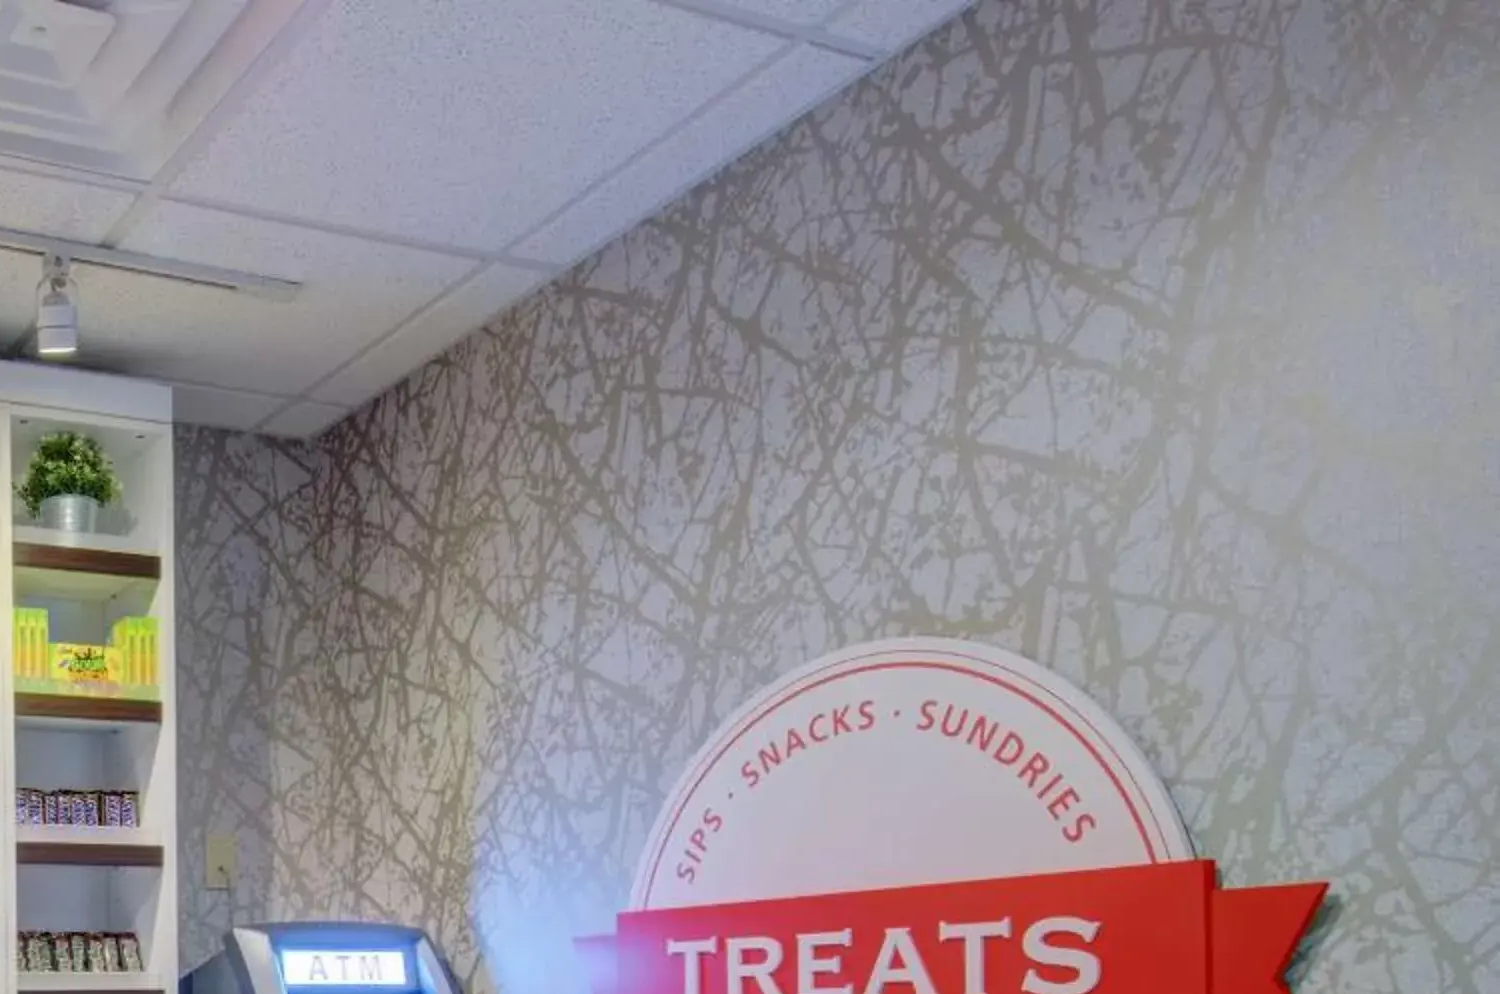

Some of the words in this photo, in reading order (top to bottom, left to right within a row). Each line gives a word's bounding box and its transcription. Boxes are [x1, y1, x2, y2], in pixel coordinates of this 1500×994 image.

[676, 807, 723, 885] SIPS
[740, 700, 875, 788] SNACKS
[916, 700, 1097, 843] SUNDRIES
[308, 956, 383, 981] ATM
